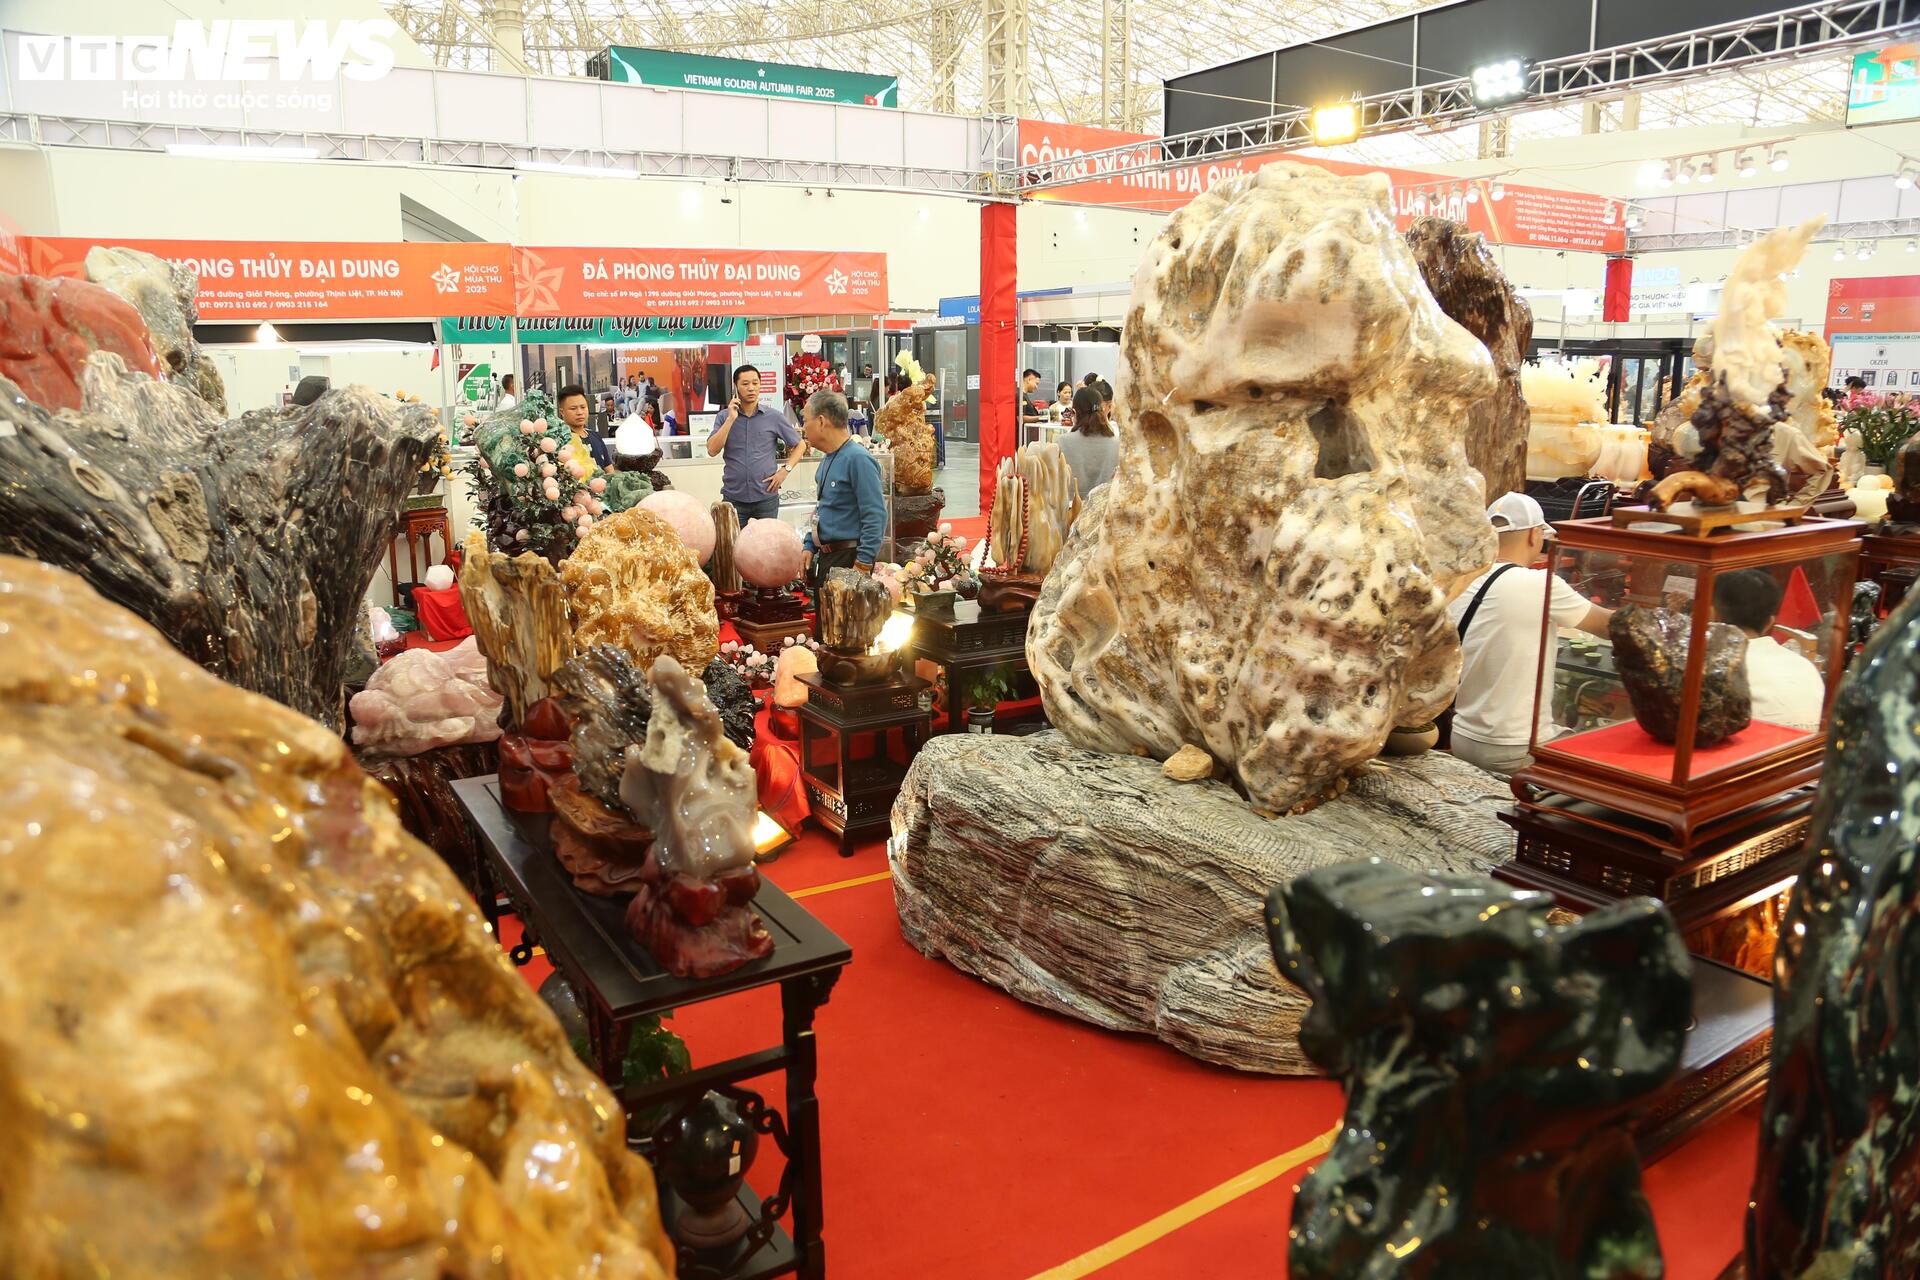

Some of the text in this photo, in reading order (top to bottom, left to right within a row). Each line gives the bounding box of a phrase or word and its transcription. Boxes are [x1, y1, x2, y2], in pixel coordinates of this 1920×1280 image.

[683, 73, 835, 98] VIETNAM GOLDEN AUTUMN FAIR 2025
[167, 252, 400, 284] ONG THỦY ĐẠI DUNG
[464, 264, 499, 275] HỘI CHỢ
[582, 258, 801, 285] ĐÁ PHONG THỦY ĐẠI DUNG
[464, 274, 503, 283] MÙA THU
[867, 279, 880, 287] THU
[465, 285, 487, 293] 2025
